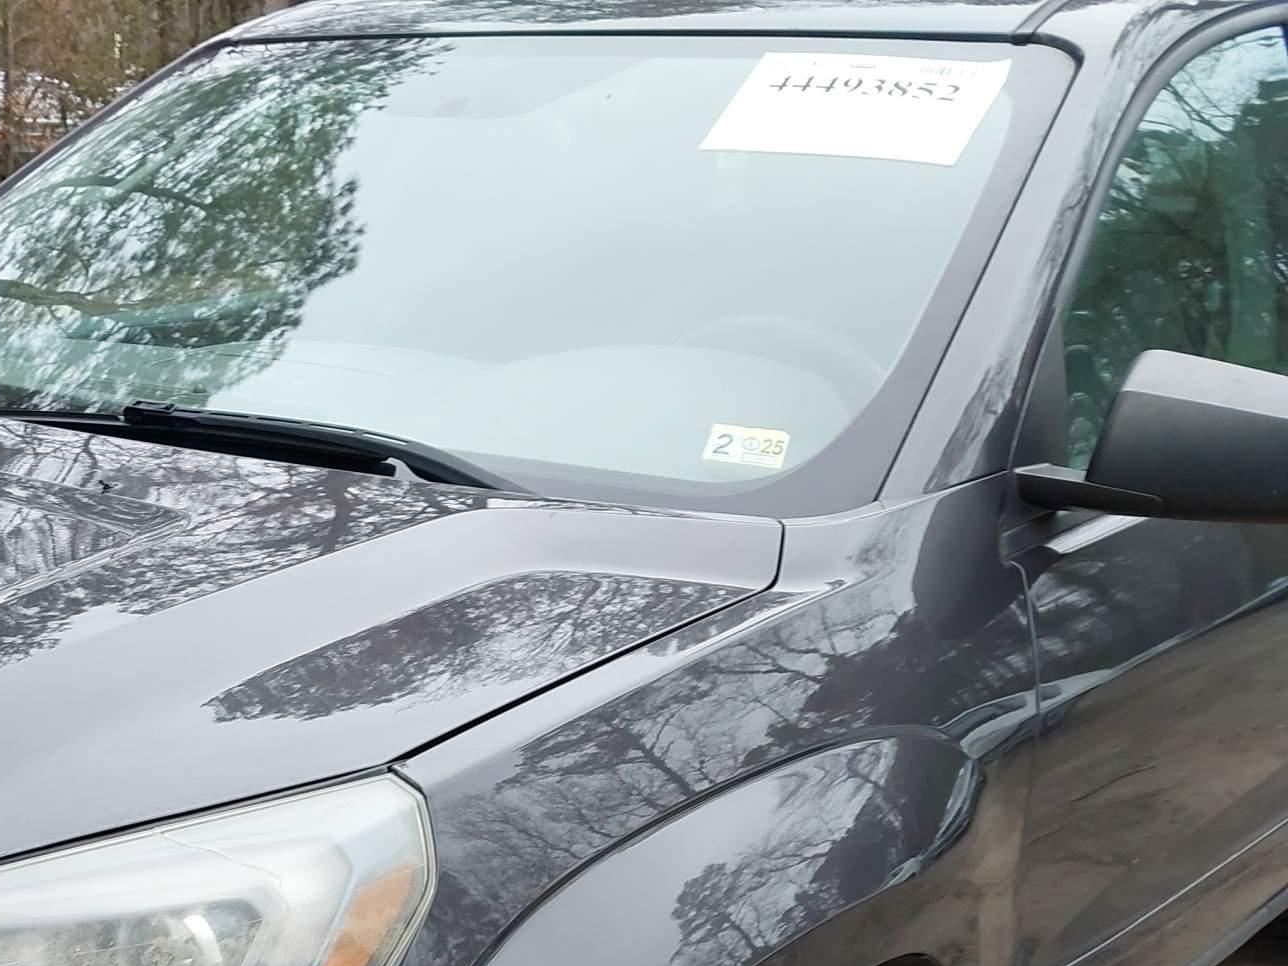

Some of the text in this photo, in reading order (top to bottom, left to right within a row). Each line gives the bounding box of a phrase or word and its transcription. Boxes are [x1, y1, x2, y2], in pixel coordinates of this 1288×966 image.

[769, 75, 961, 101] 44493852
[712, 433, 785, 456] 2 25
